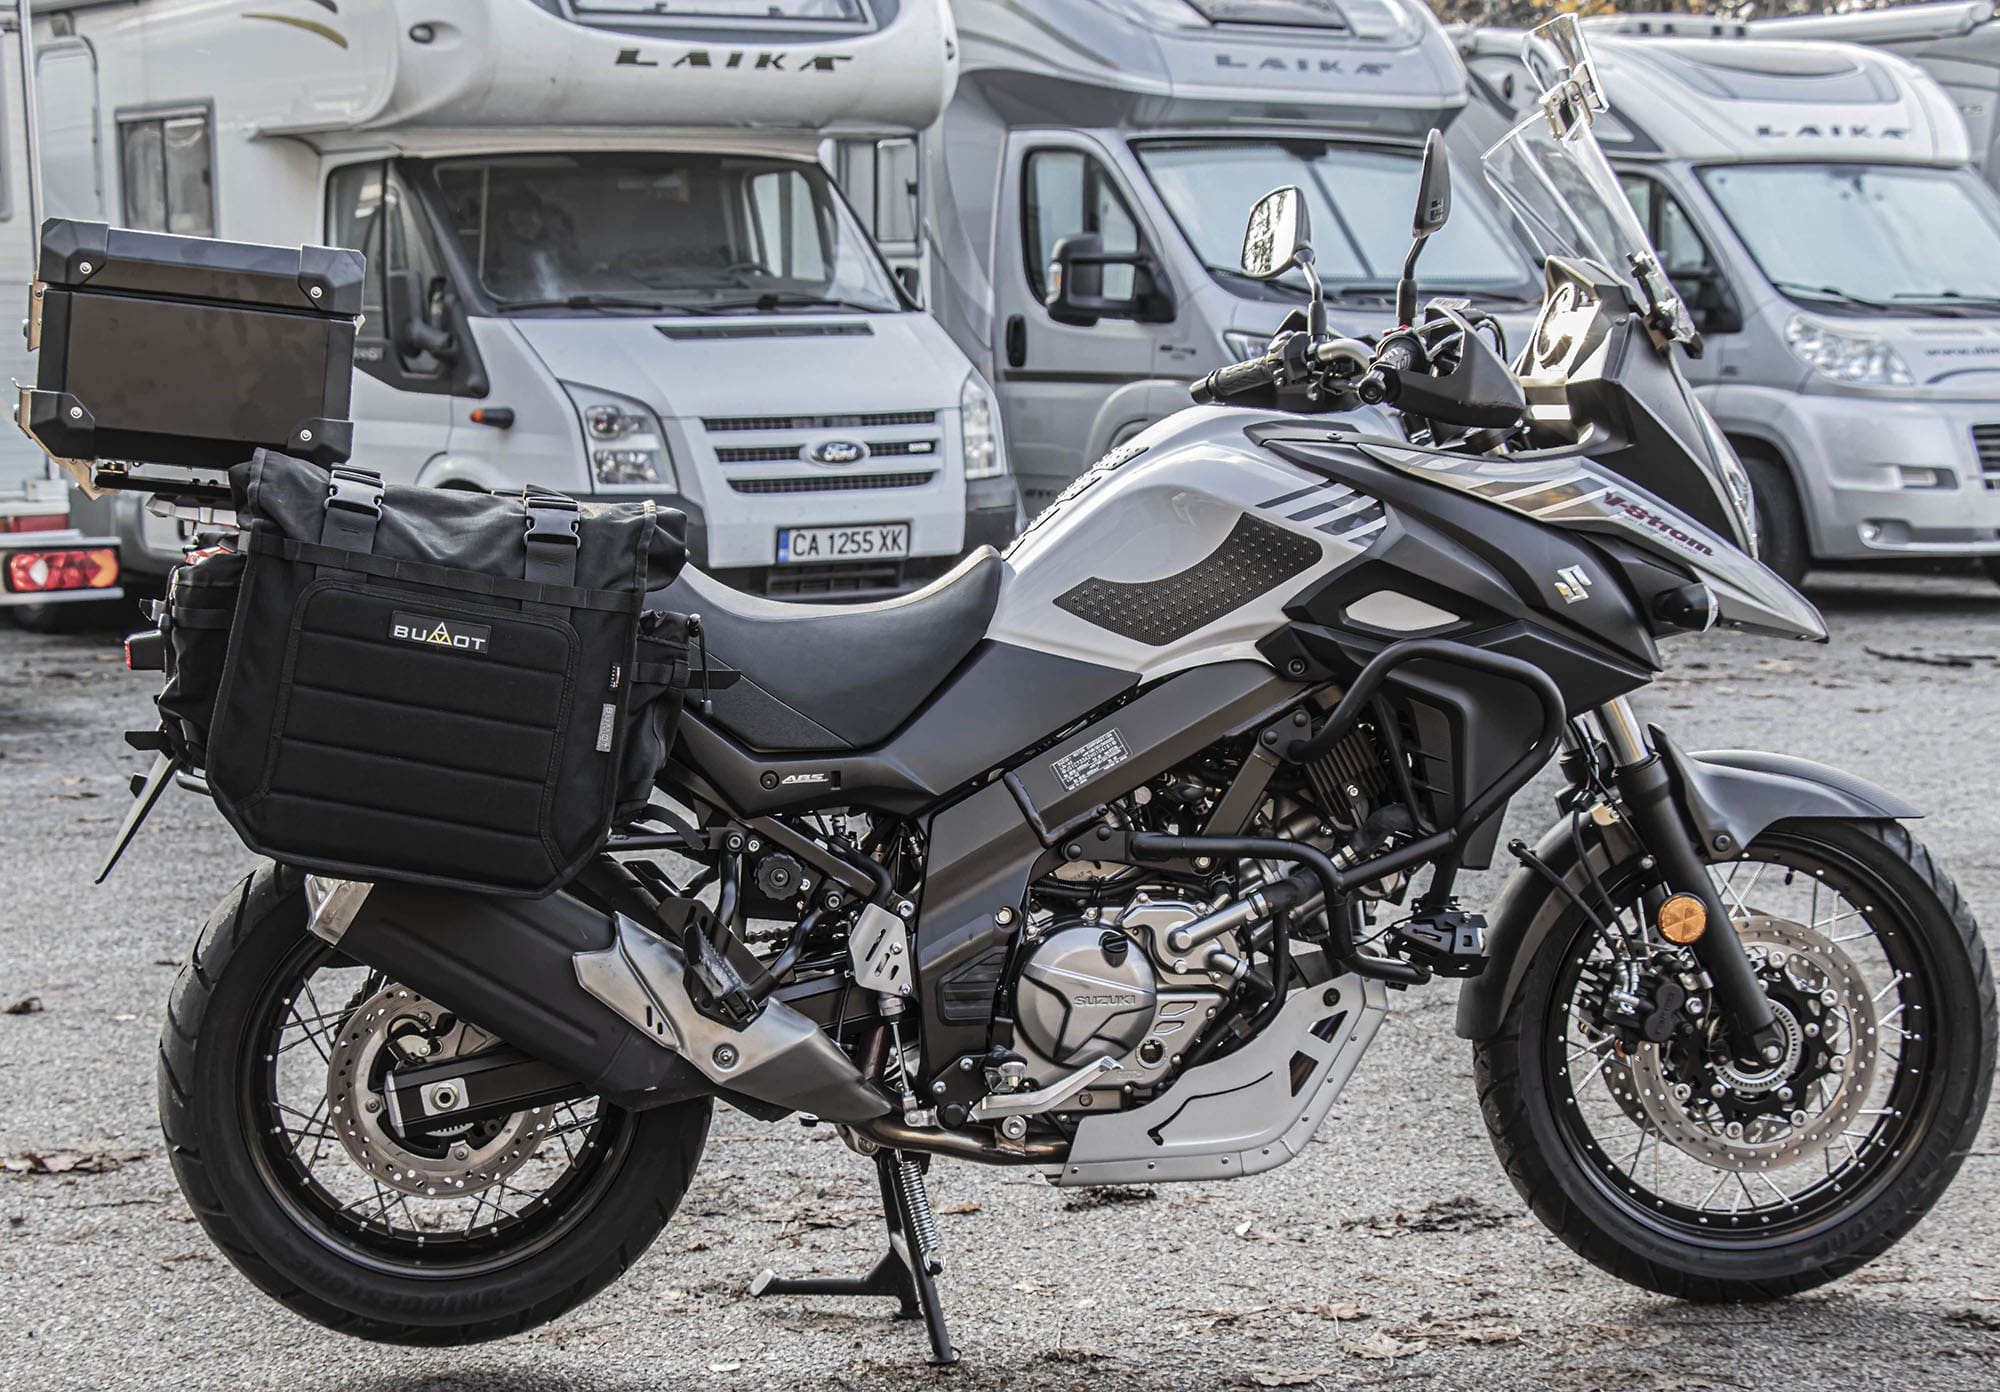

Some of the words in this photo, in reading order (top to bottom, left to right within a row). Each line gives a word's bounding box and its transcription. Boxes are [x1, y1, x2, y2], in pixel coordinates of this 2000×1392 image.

[615, 49, 852, 71] LAIKA
[1216, 54, 1392, 76] LAIKA
[1757, 125, 1912, 139] LAIKA
[824, 443, 857, 462] Ford
[1603, 491, 1715, 556] V-Strom
[793, 533, 819, 556] CA
[828, 531, 873, 554] 1255
[879, 529, 902, 552] XK
[782, 773, 828, 784] ABS
[1073, 994, 1136, 1007] SUZUKI
